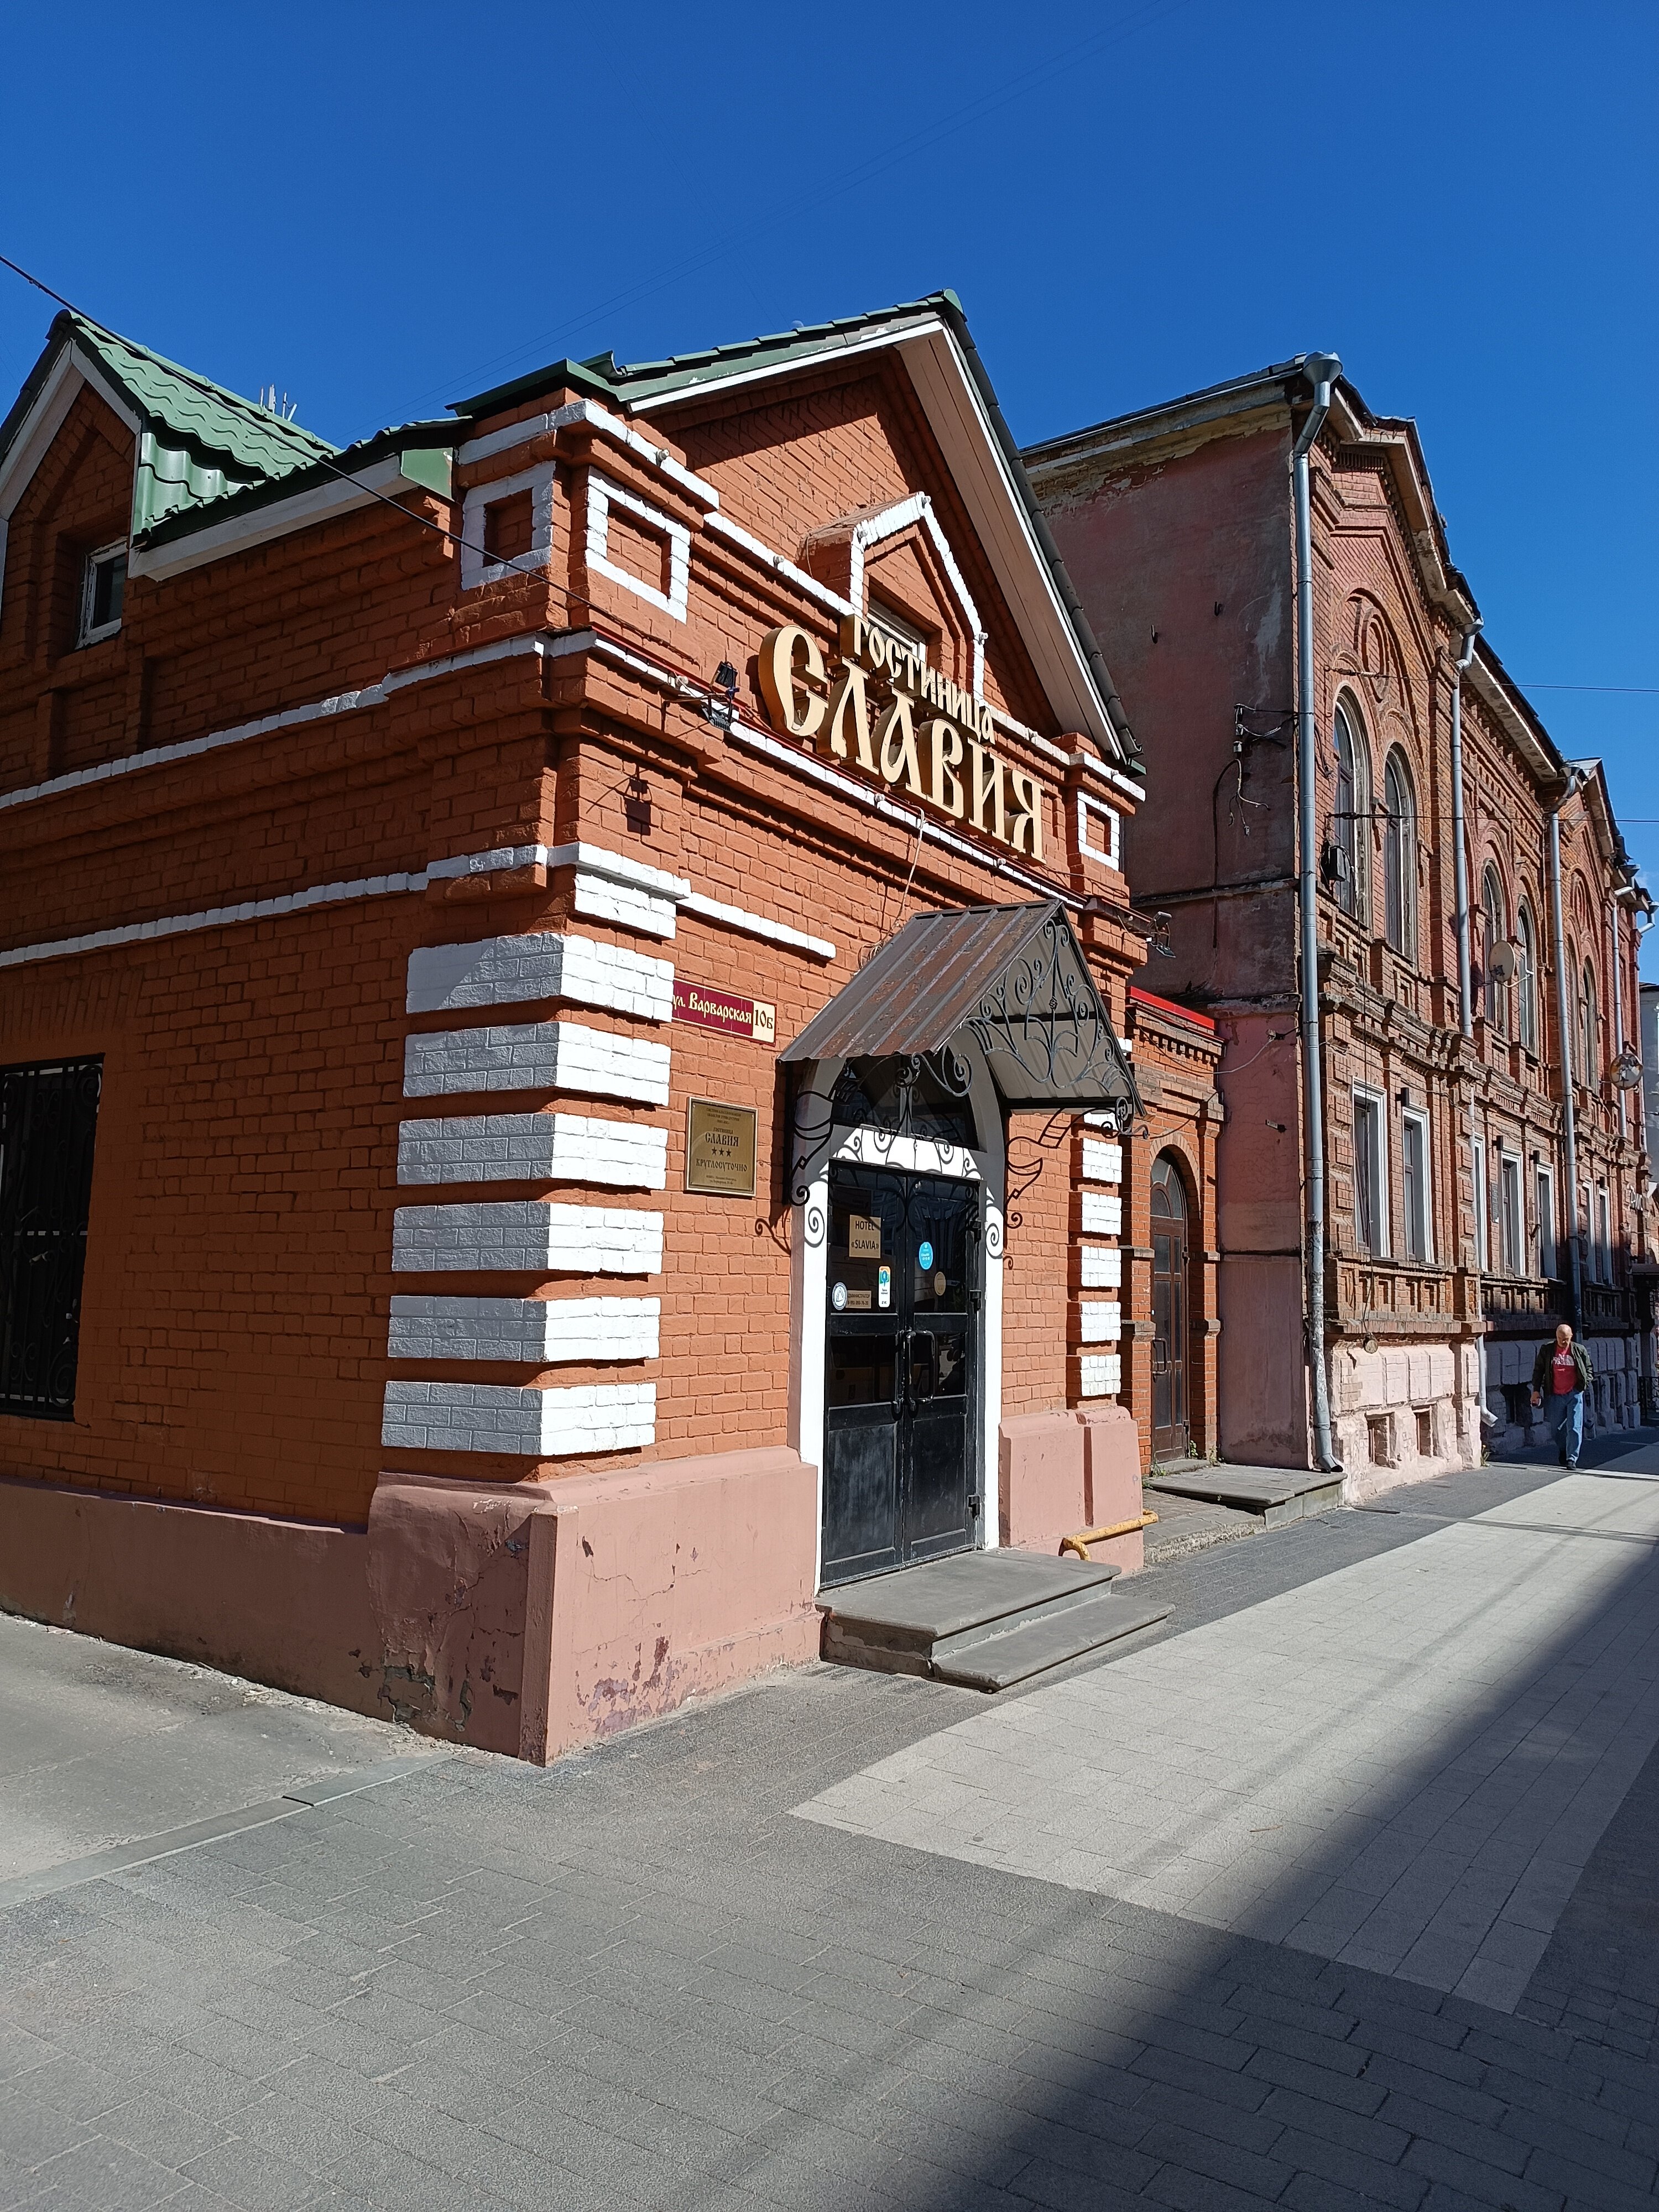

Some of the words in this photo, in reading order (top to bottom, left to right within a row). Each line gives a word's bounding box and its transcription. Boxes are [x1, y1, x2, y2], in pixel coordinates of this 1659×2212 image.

[769, 624, 1047, 867] СЛАВИЯ
[672, 994, 686, 1010] ул.
[688, 992, 752, 1025] Варварская
[705, 1132, 739, 1147] СЛАВИЯ
[696, 1158, 748, 1172] КРУГЛОСУТОЧНО
[854, 1220, 875, 1231] HOTEL
[851, 1239, 879, 1250] «SLAVIA»
